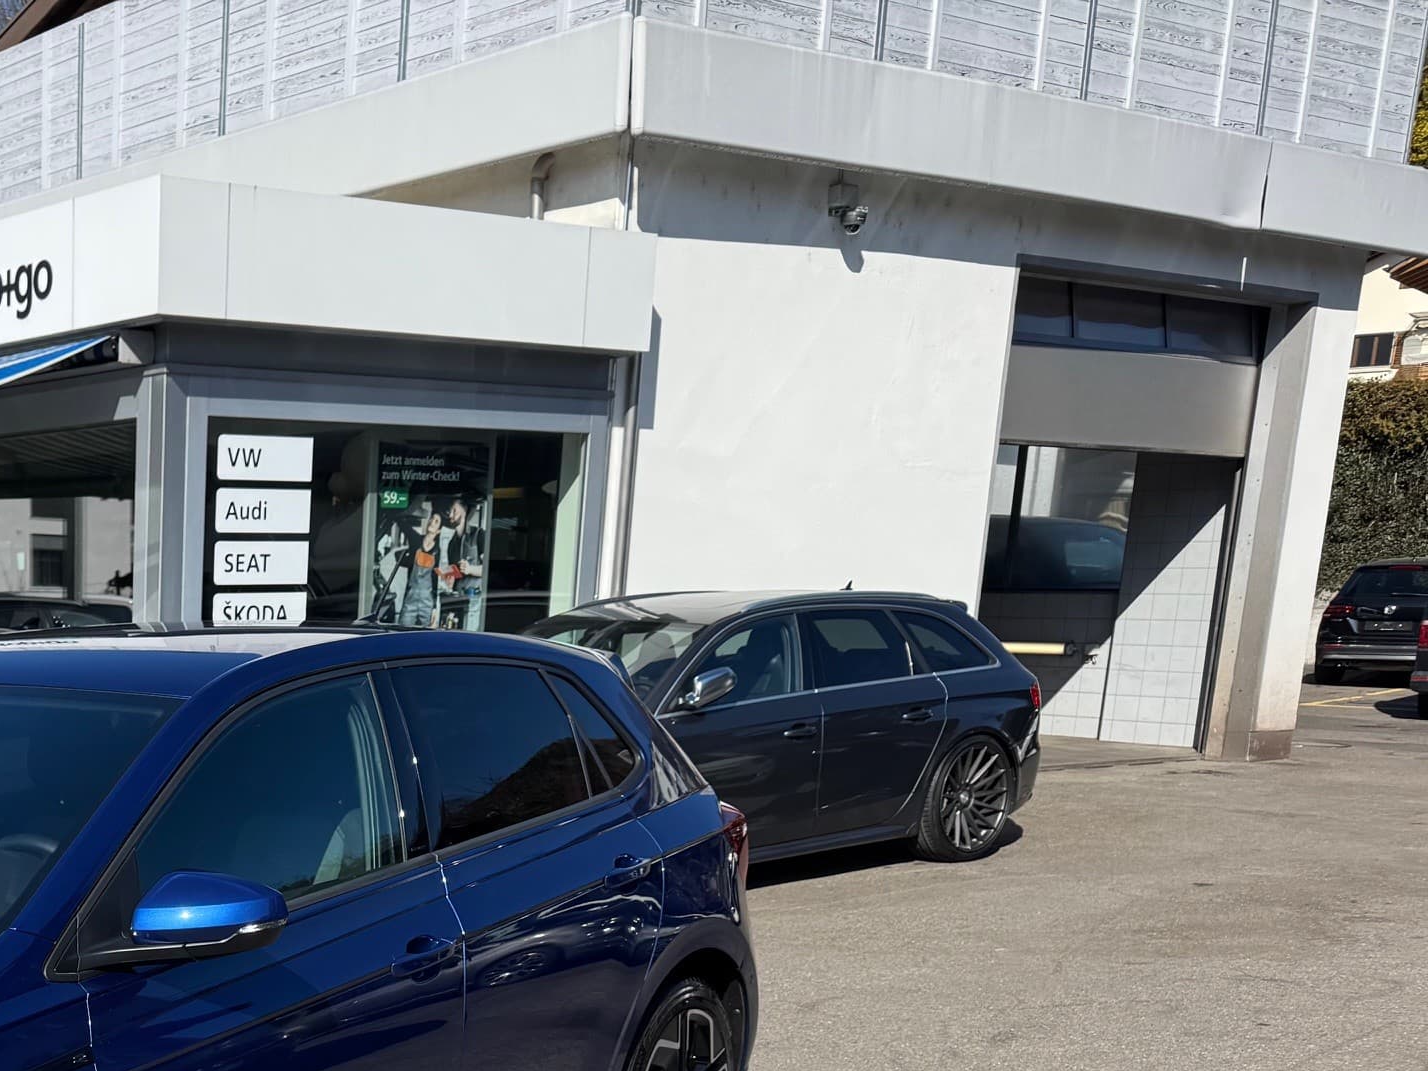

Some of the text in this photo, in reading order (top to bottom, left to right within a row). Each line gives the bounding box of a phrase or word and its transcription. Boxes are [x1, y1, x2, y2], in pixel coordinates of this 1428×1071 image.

[227, 447, 262, 468] VW
[382, 454, 445, 466] Jetzt anmelden
[381, 469, 460, 481] zum Winter-Check!
[225, 500, 268, 521] Audi
[224, 553, 271, 574] SEAT
